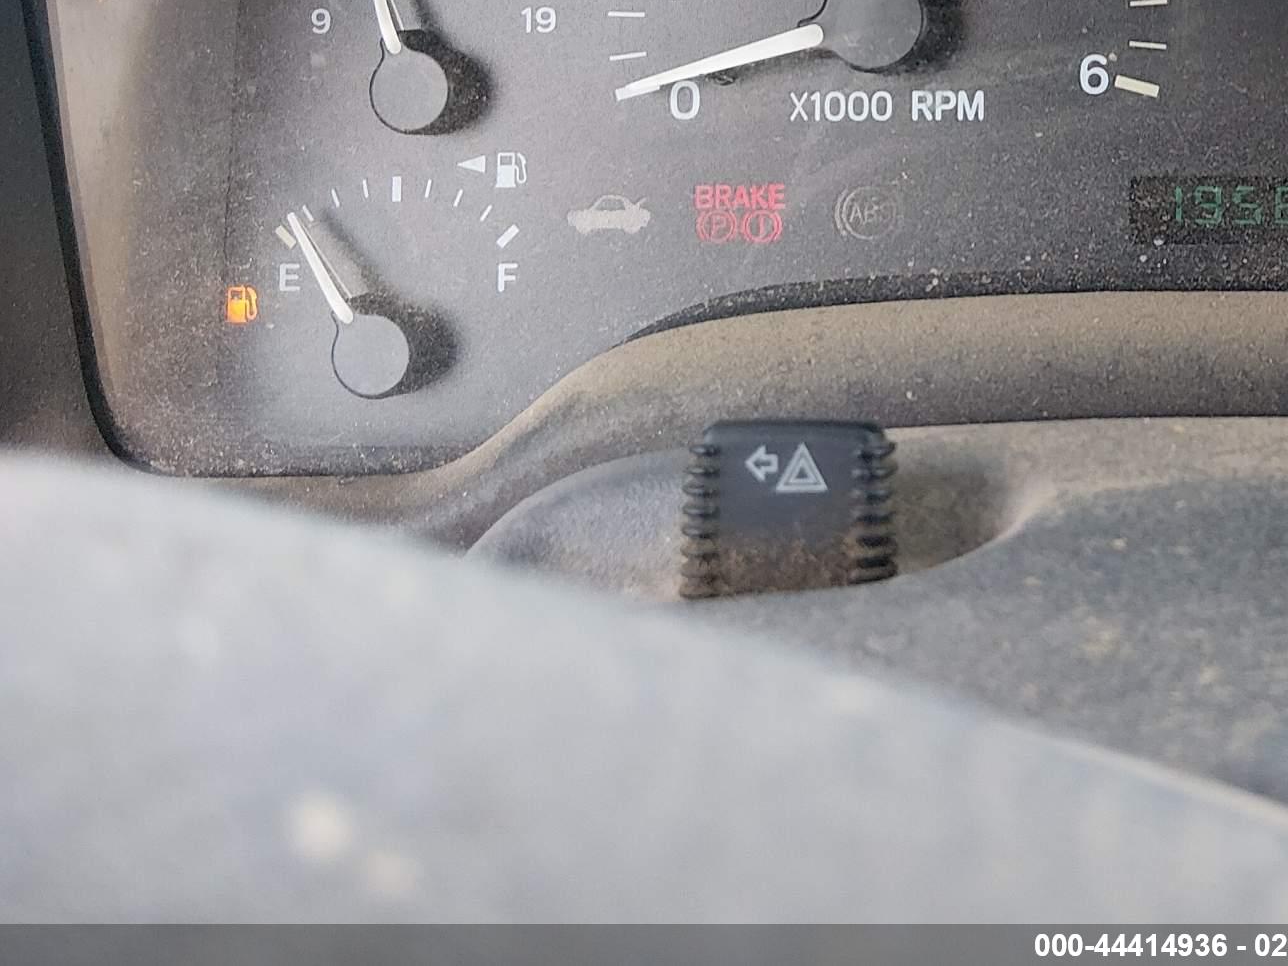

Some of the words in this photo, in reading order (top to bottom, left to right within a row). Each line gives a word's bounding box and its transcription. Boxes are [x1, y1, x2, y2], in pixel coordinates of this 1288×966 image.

[309, 8, 332, 34] 9
[521, 7, 558, 33] 19
[1078, 54, 1110, 95] 6
[670, 81, 701, 120] 0
[789, 93, 894, 121] X1000
[910, 91, 985, 120] RPM
[695, 184, 786, 209] BRAKE
[279, 264, 300, 292] E
[498, 263, 519, 292] F
